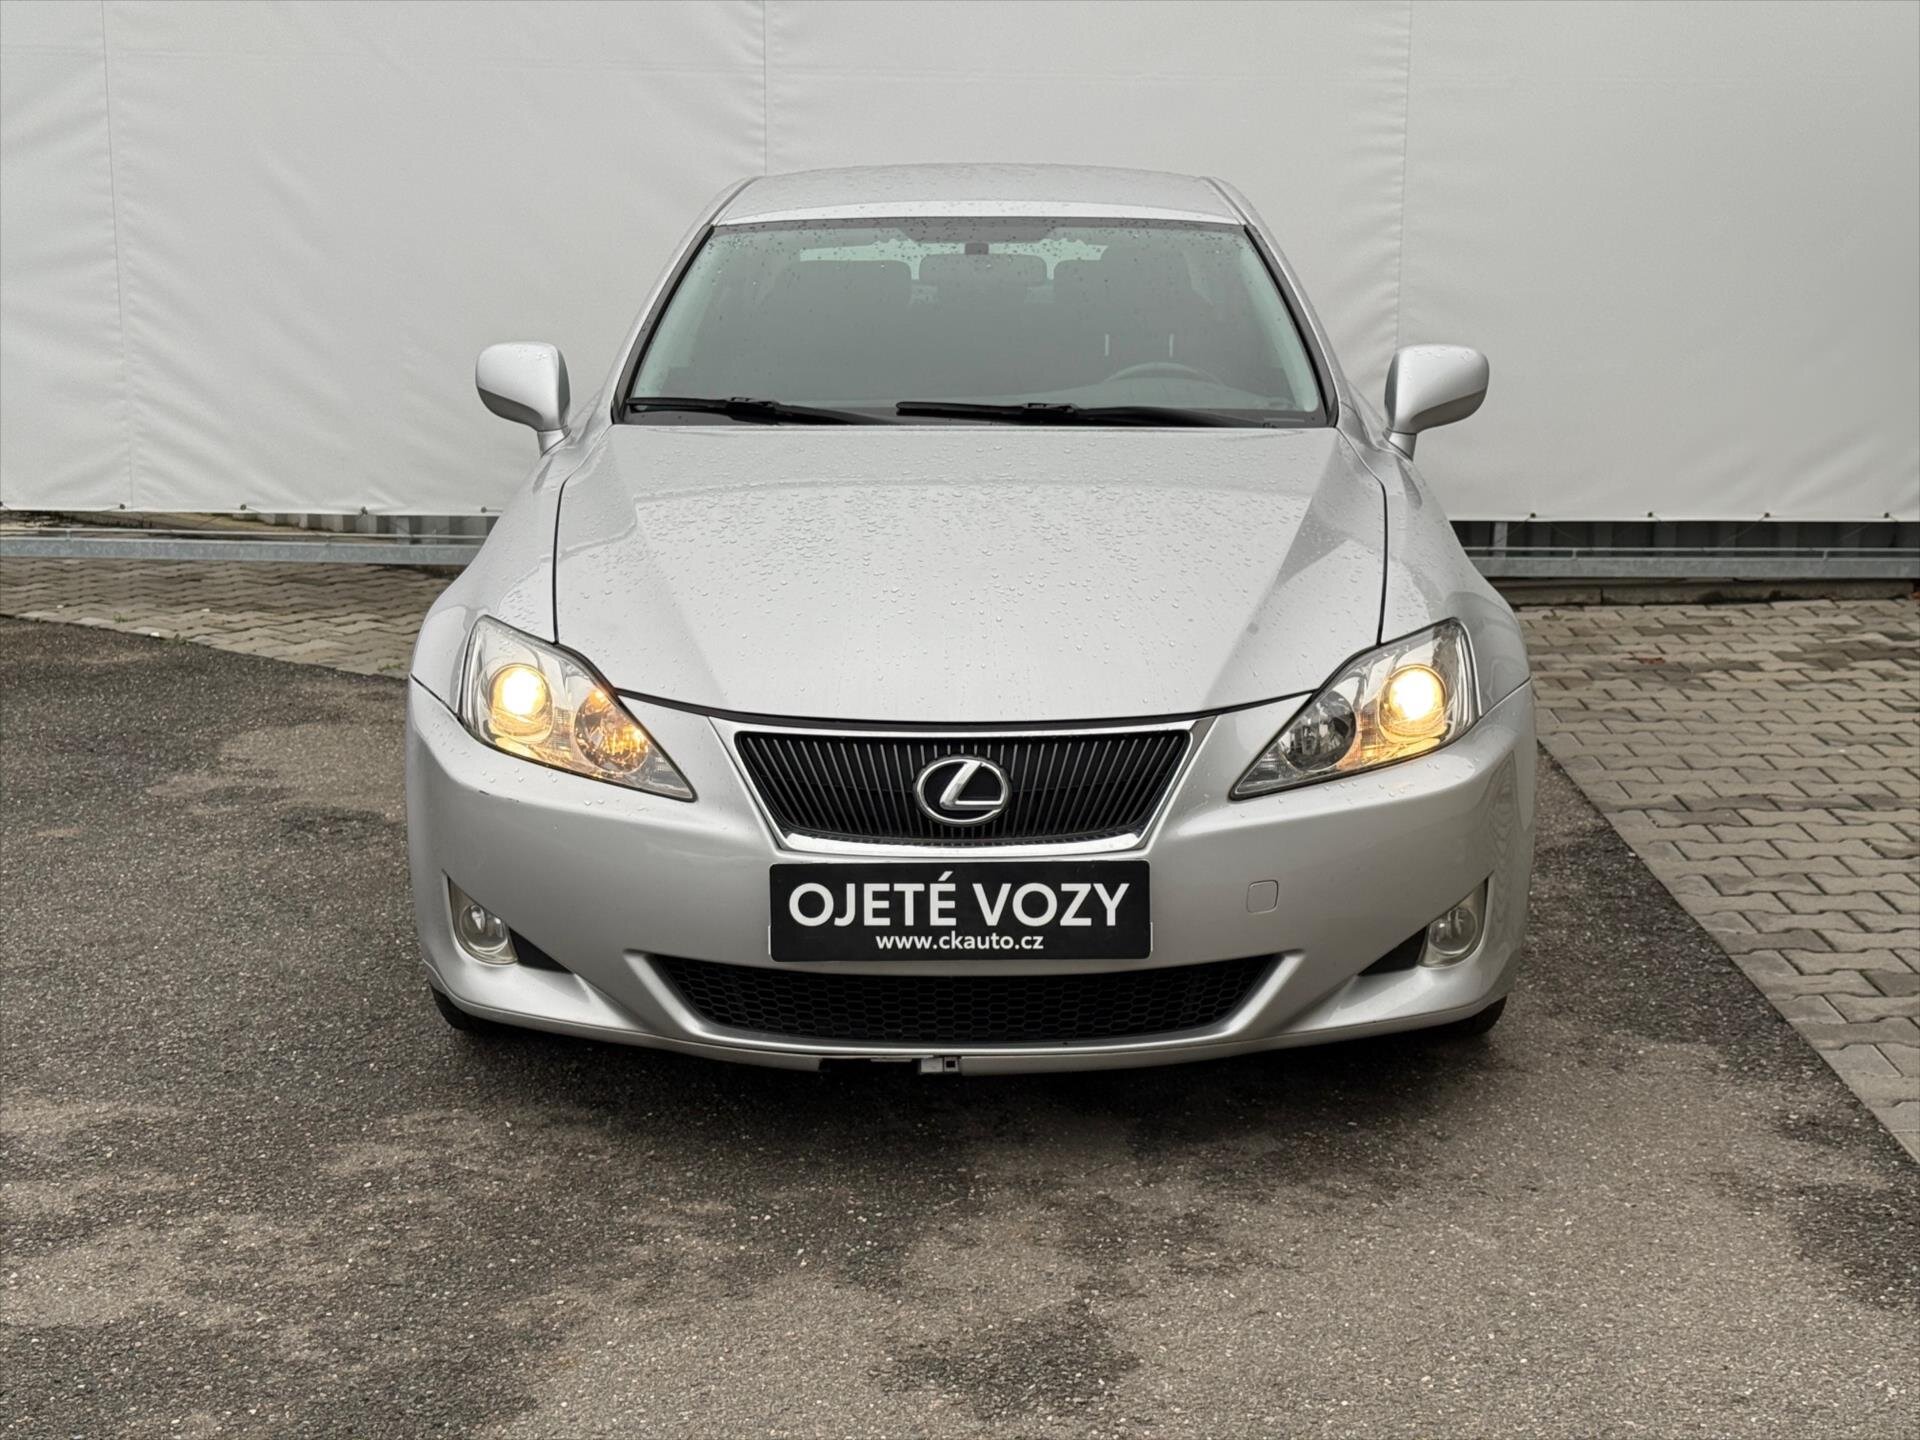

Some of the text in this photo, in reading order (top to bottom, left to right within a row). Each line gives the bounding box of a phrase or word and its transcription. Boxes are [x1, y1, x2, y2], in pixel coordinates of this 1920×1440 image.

[788, 870, 1130, 927] OJETÉ VOZY
[876, 930, 1044, 950] www.ckauto.cz
